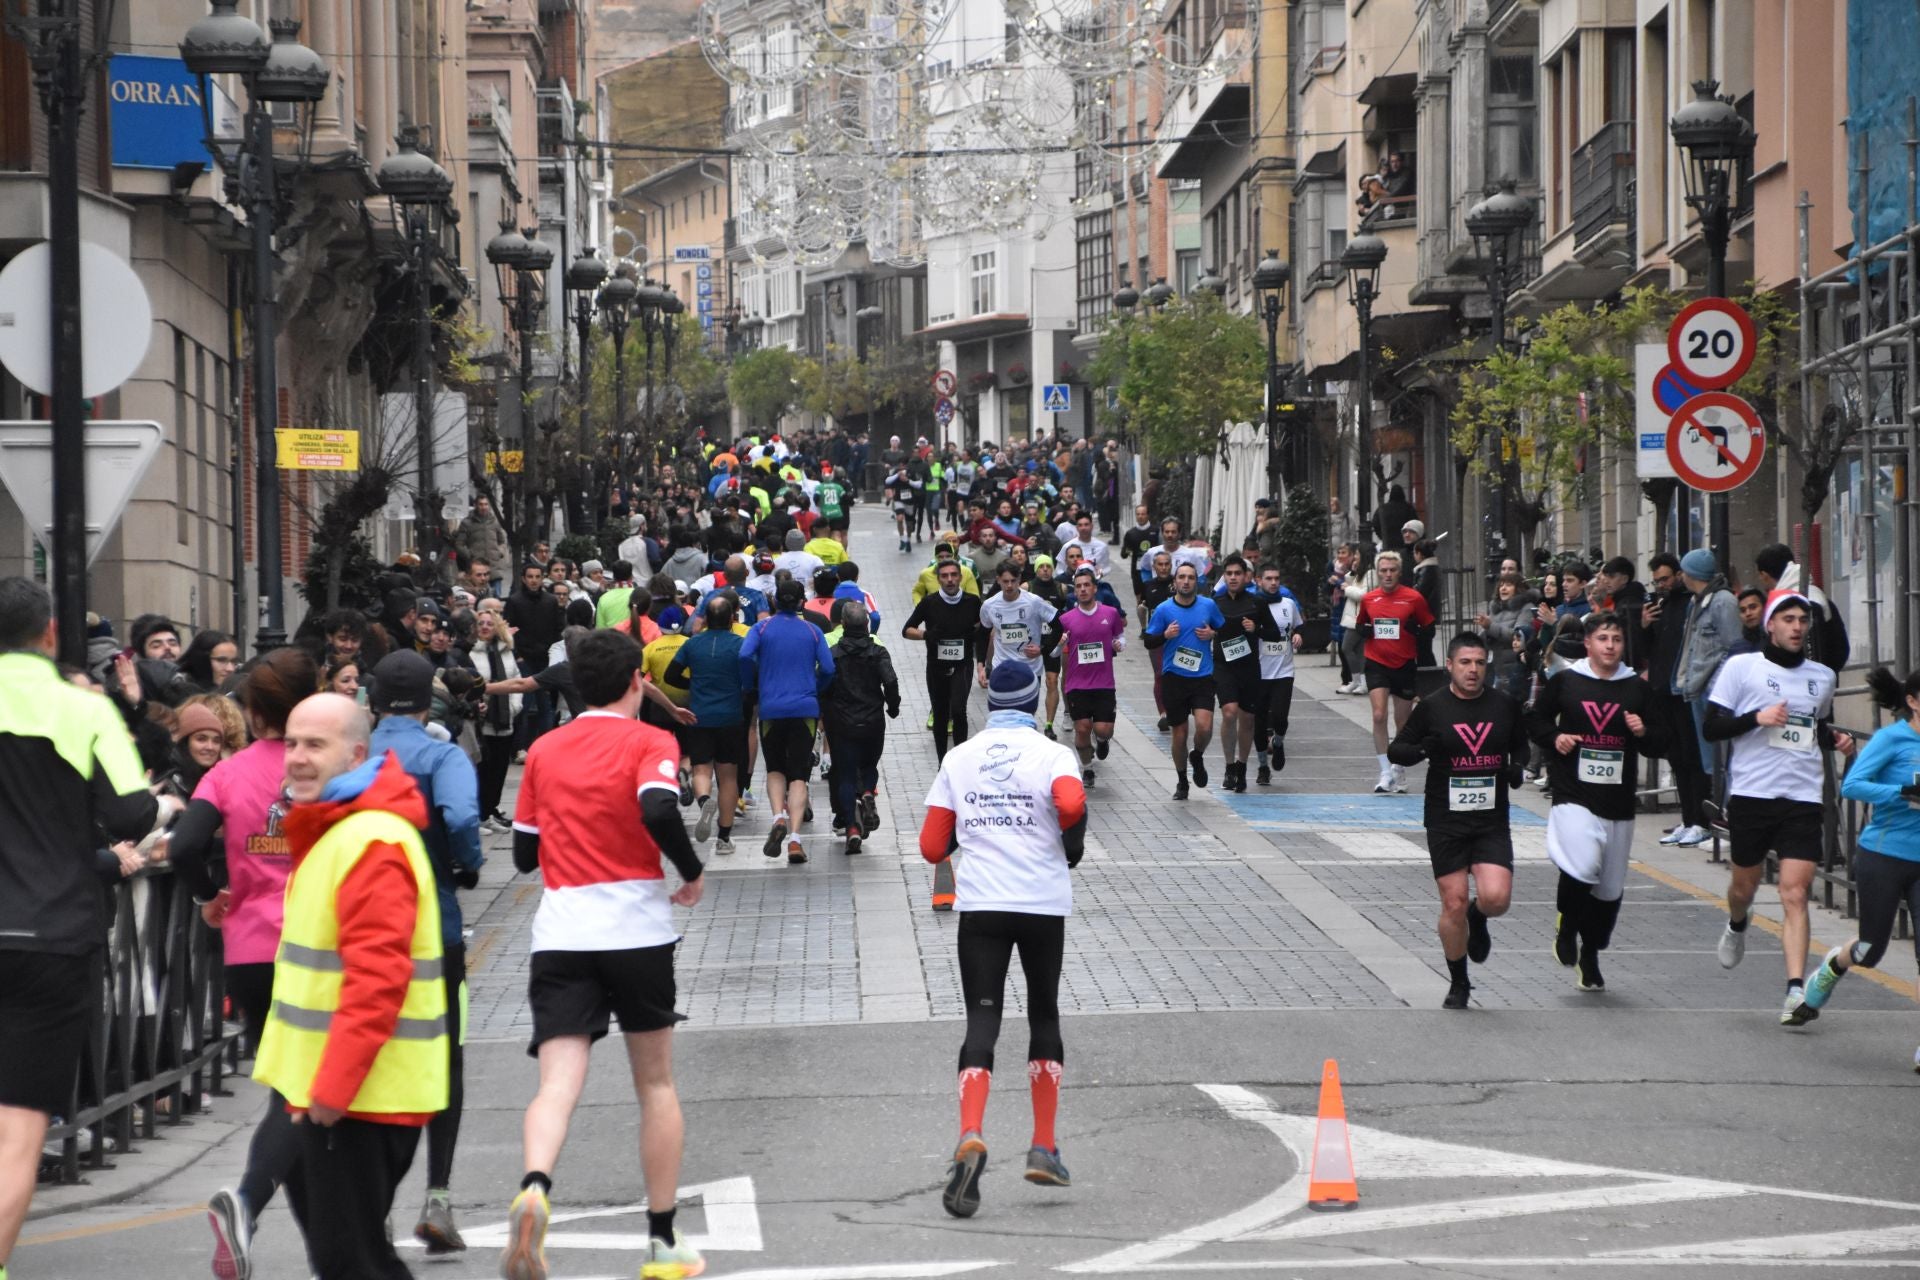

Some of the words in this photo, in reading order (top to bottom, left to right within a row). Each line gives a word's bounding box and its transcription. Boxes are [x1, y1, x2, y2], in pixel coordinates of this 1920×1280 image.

[676, 248, 710, 259] MONREAL
[1688, 329, 1735, 359] 20
[298, 433, 324, 441] UTILIZA
[824, 488, 838, 505] 20
[1005, 631, 1023, 640] 208
[1378, 627, 1395, 635] 396
[942, 648, 960, 656] 482
[1228, 645, 1246, 657] 369
[1266, 644, 1283, 652] 150
[1083, 651, 1099, 660] 391
[1178, 656, 1196, 667] 429
[1583, 735, 1626, 746] ALERIO
[1782, 730, 1800, 743] 40
[1451, 754, 1502, 767] VALERIO
[1587, 764, 1615, 777] 320
[979, 793, 1005, 802] Speed
[1007, 793, 1033, 801] Queen
[1458, 792, 1487, 804] 225
[964, 816, 1013, 828] PONTIGO
[1016, 816, 1038, 827] S.A.
